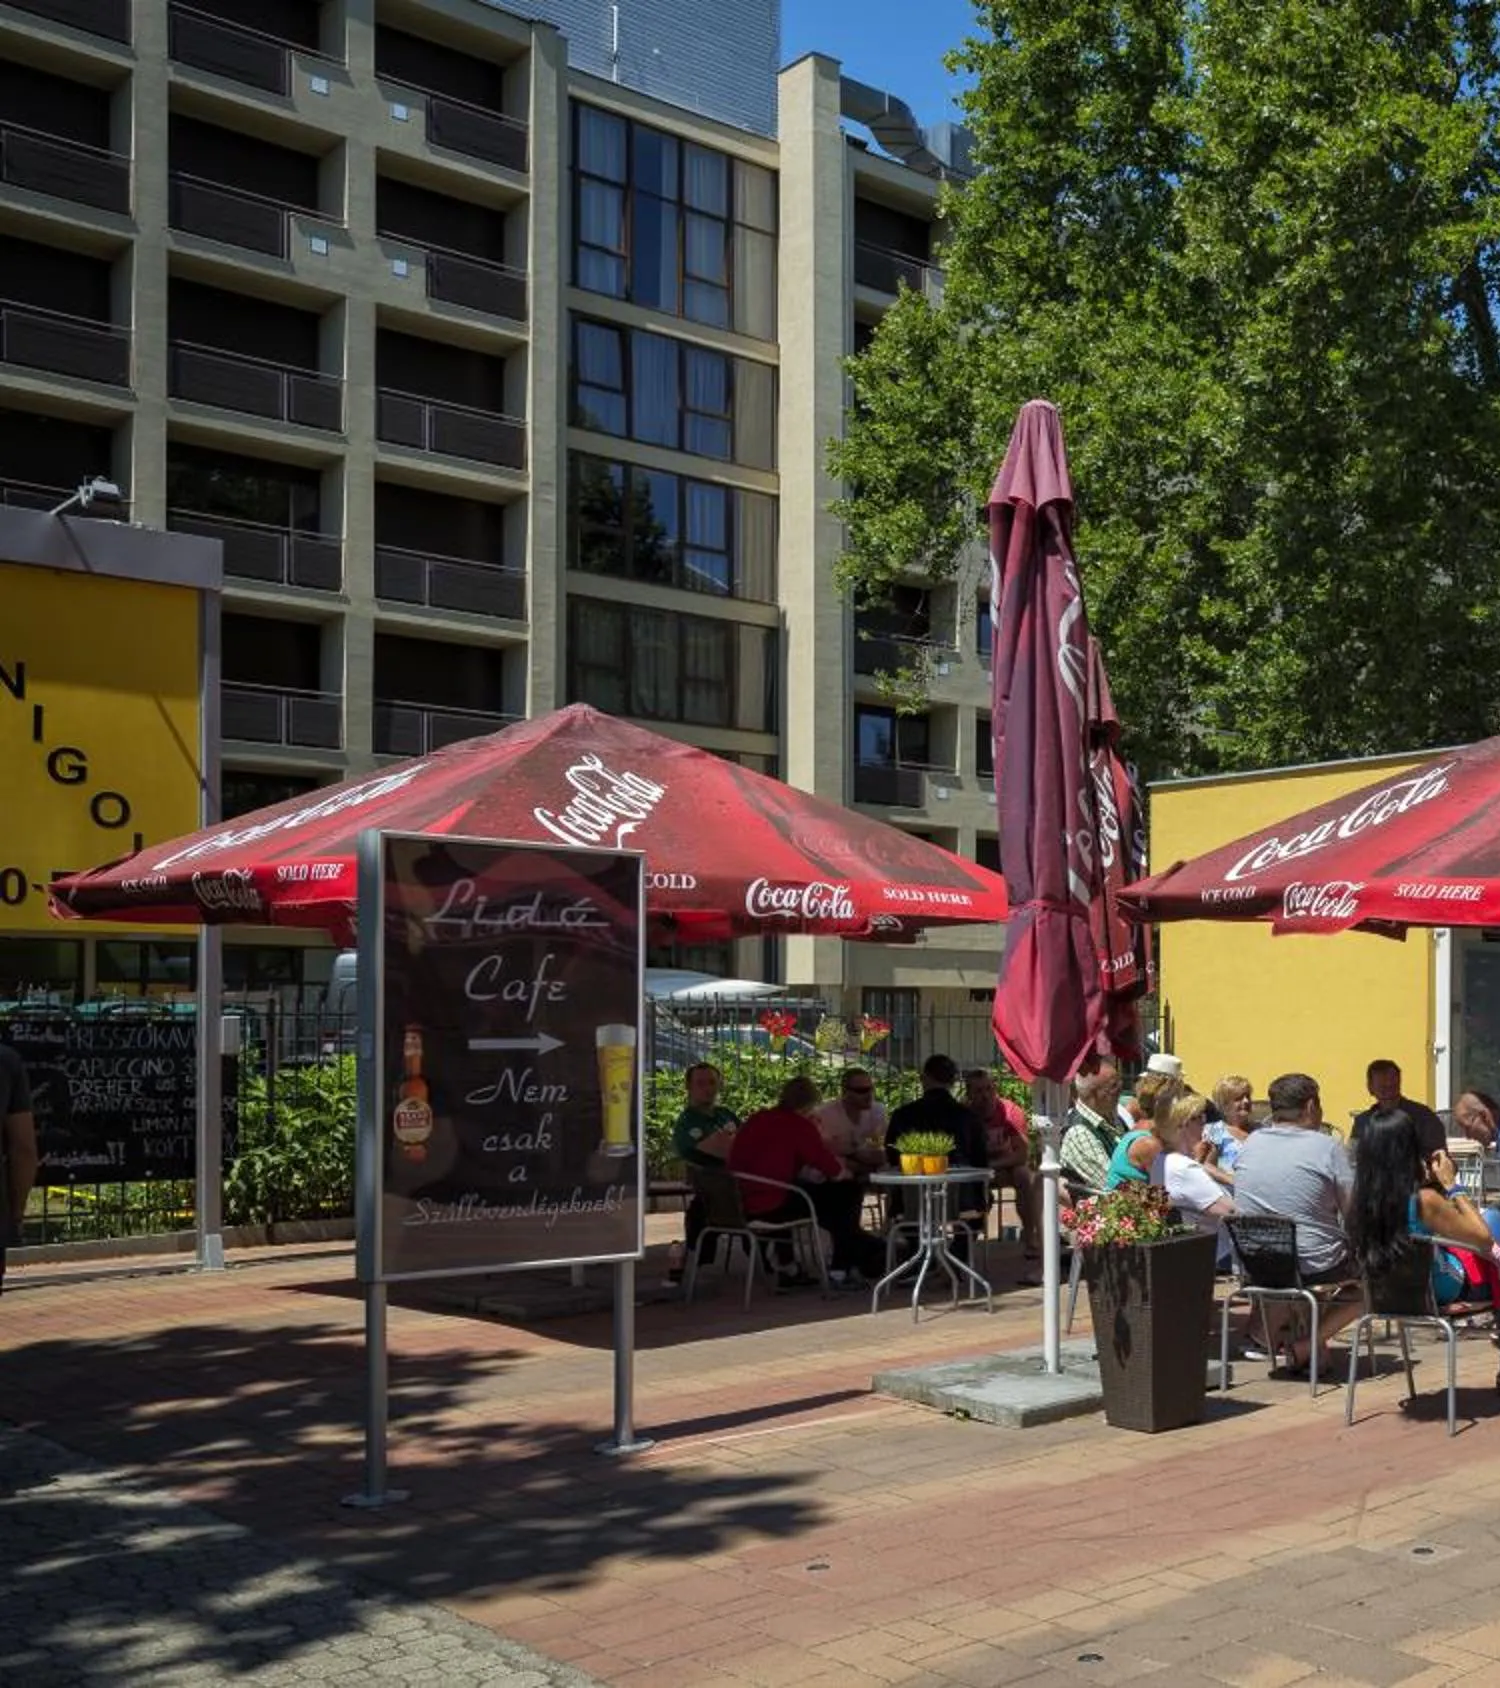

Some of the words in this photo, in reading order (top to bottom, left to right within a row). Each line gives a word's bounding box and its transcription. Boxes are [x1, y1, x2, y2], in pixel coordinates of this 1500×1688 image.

[277, 865, 307, 882] SOLD
[309, 863, 344, 880] HERE
[883, 887, 924, 901] SOLD
[1393, 883, 1435, 898] SOLD
[1437, 884, 1486, 901] HERE
[464, 953, 569, 1022] Cafe
[466, 1068, 569, 1104] Nem
[483, 1114, 553, 1151] csak
[508, 1165, 528, 1182] a
